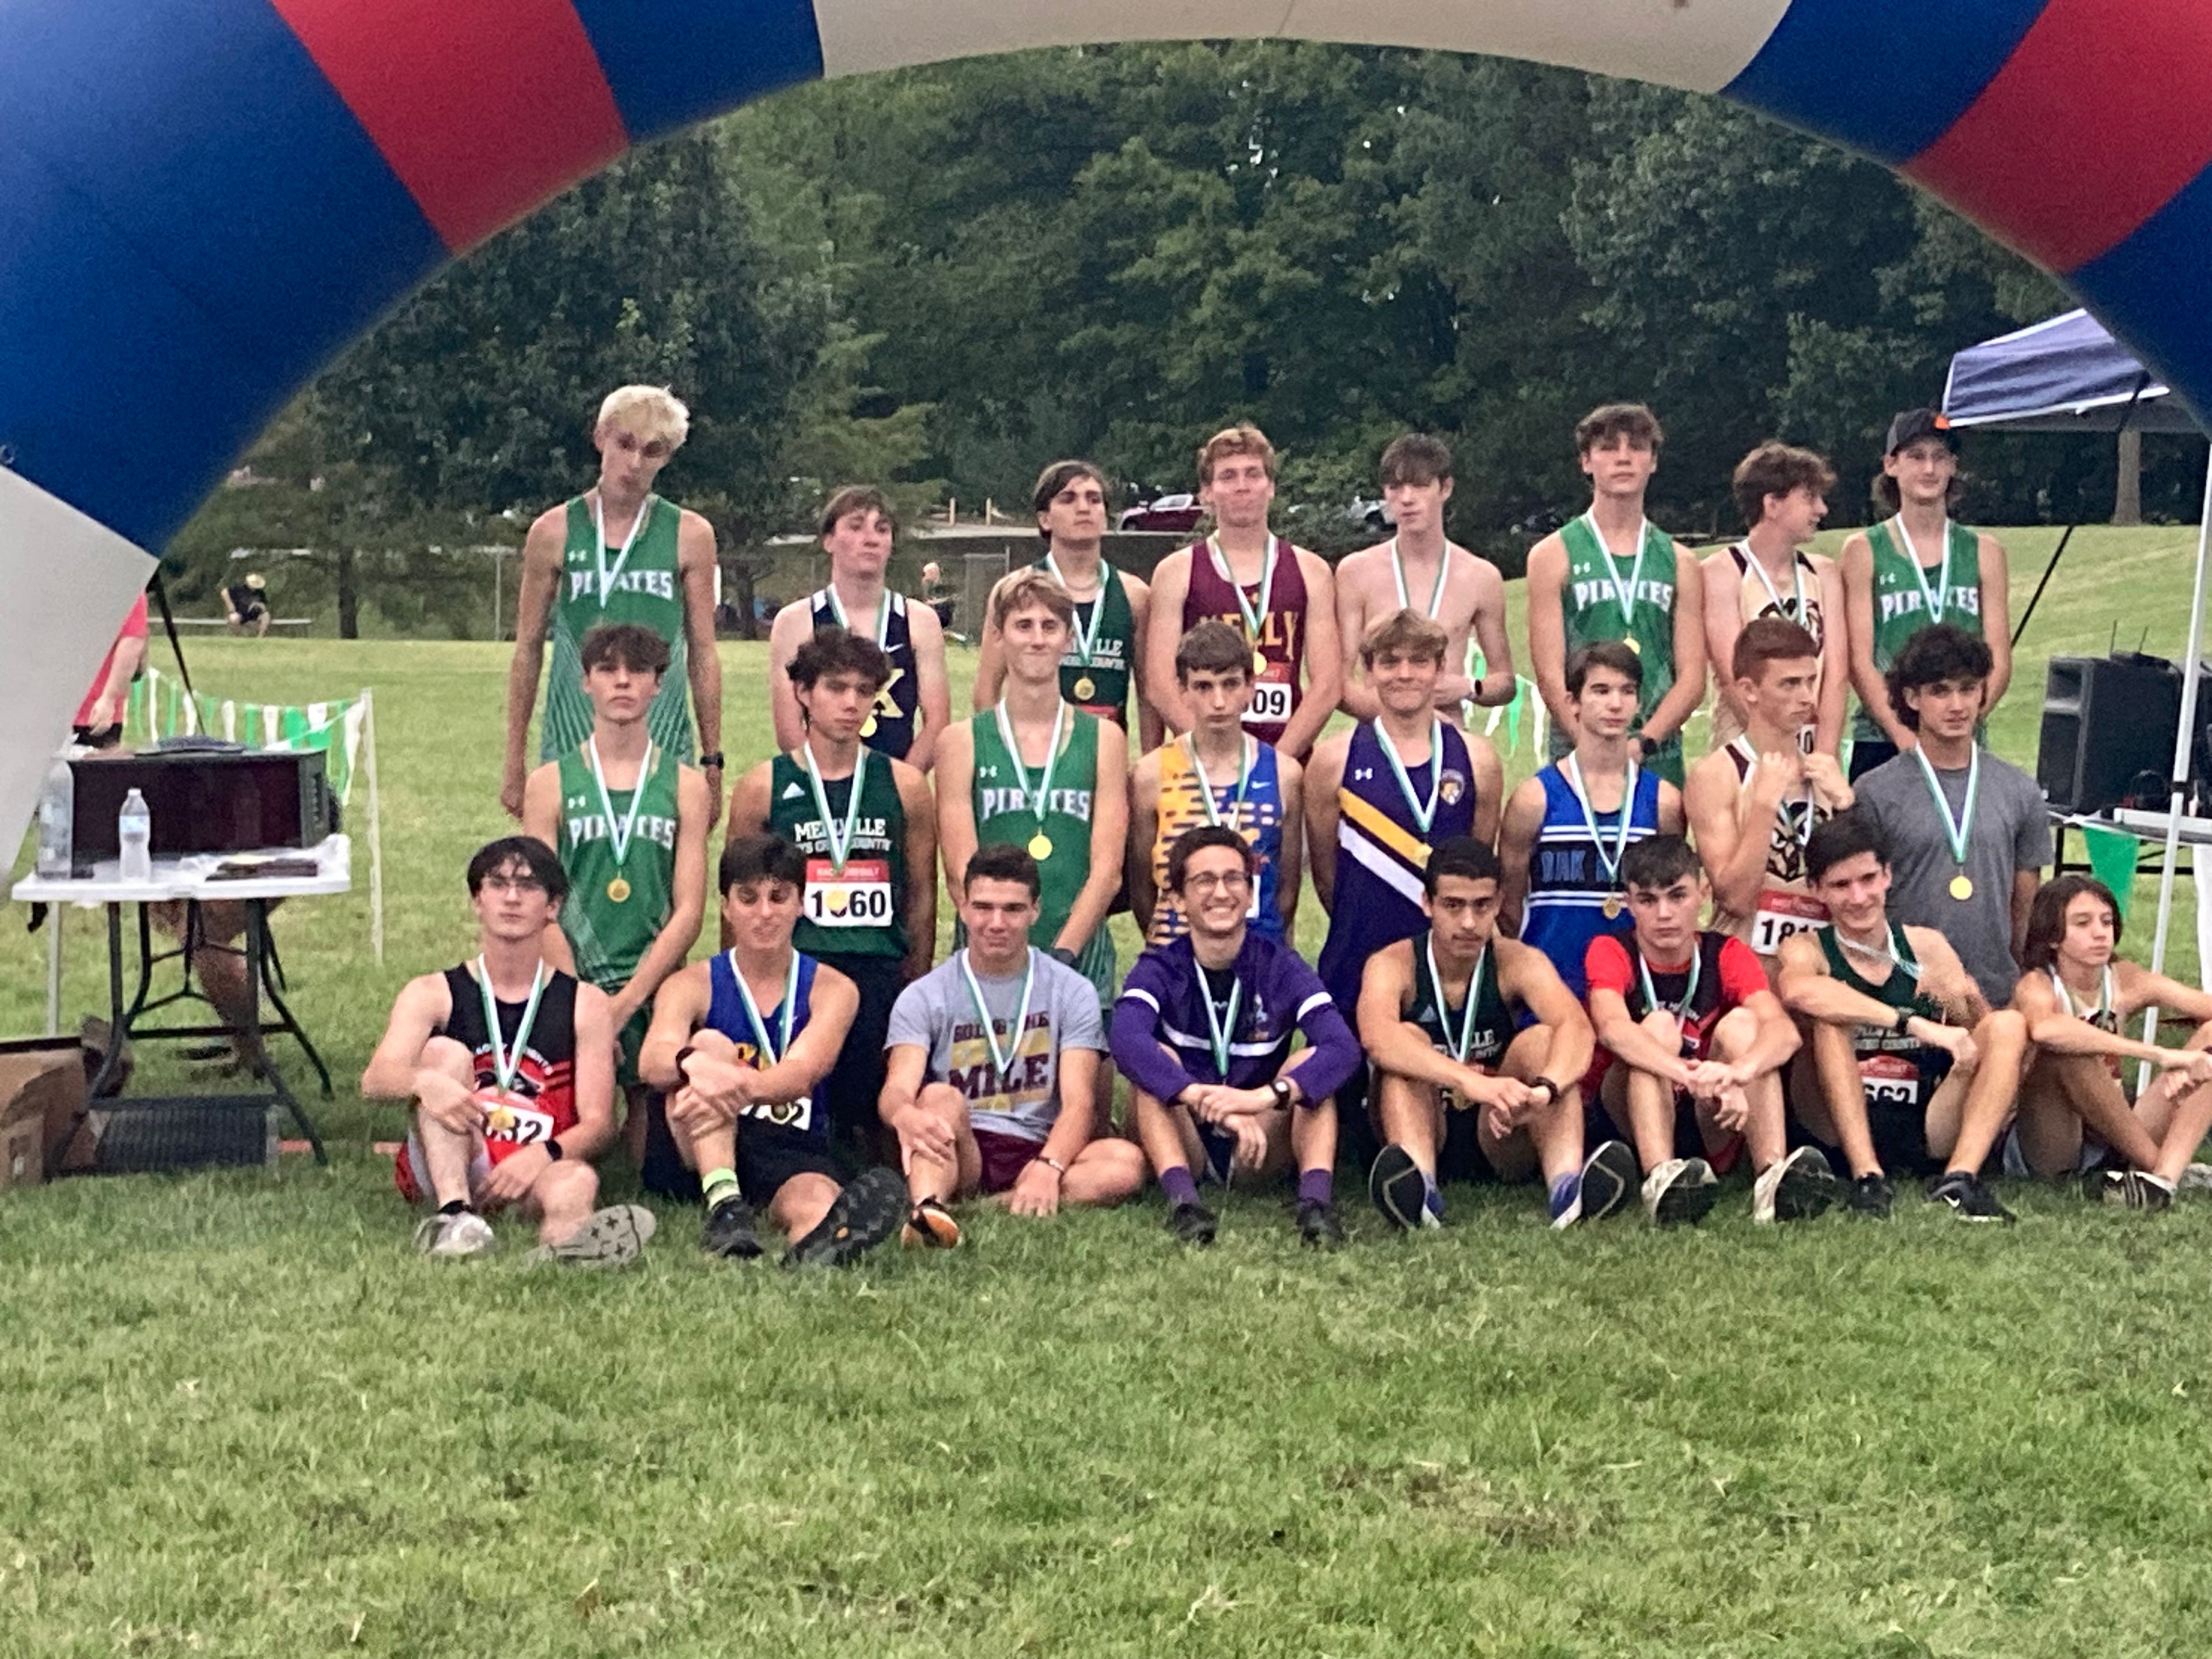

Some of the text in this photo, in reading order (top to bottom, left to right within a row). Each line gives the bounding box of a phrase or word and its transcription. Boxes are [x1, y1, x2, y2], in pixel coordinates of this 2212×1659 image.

[569, 570, 673, 602] PIATES
[1574, 579, 1673, 612] PIRTES
[1761, 918, 1819, 945] 18
[949, 1053, 1050, 1100] MILE
